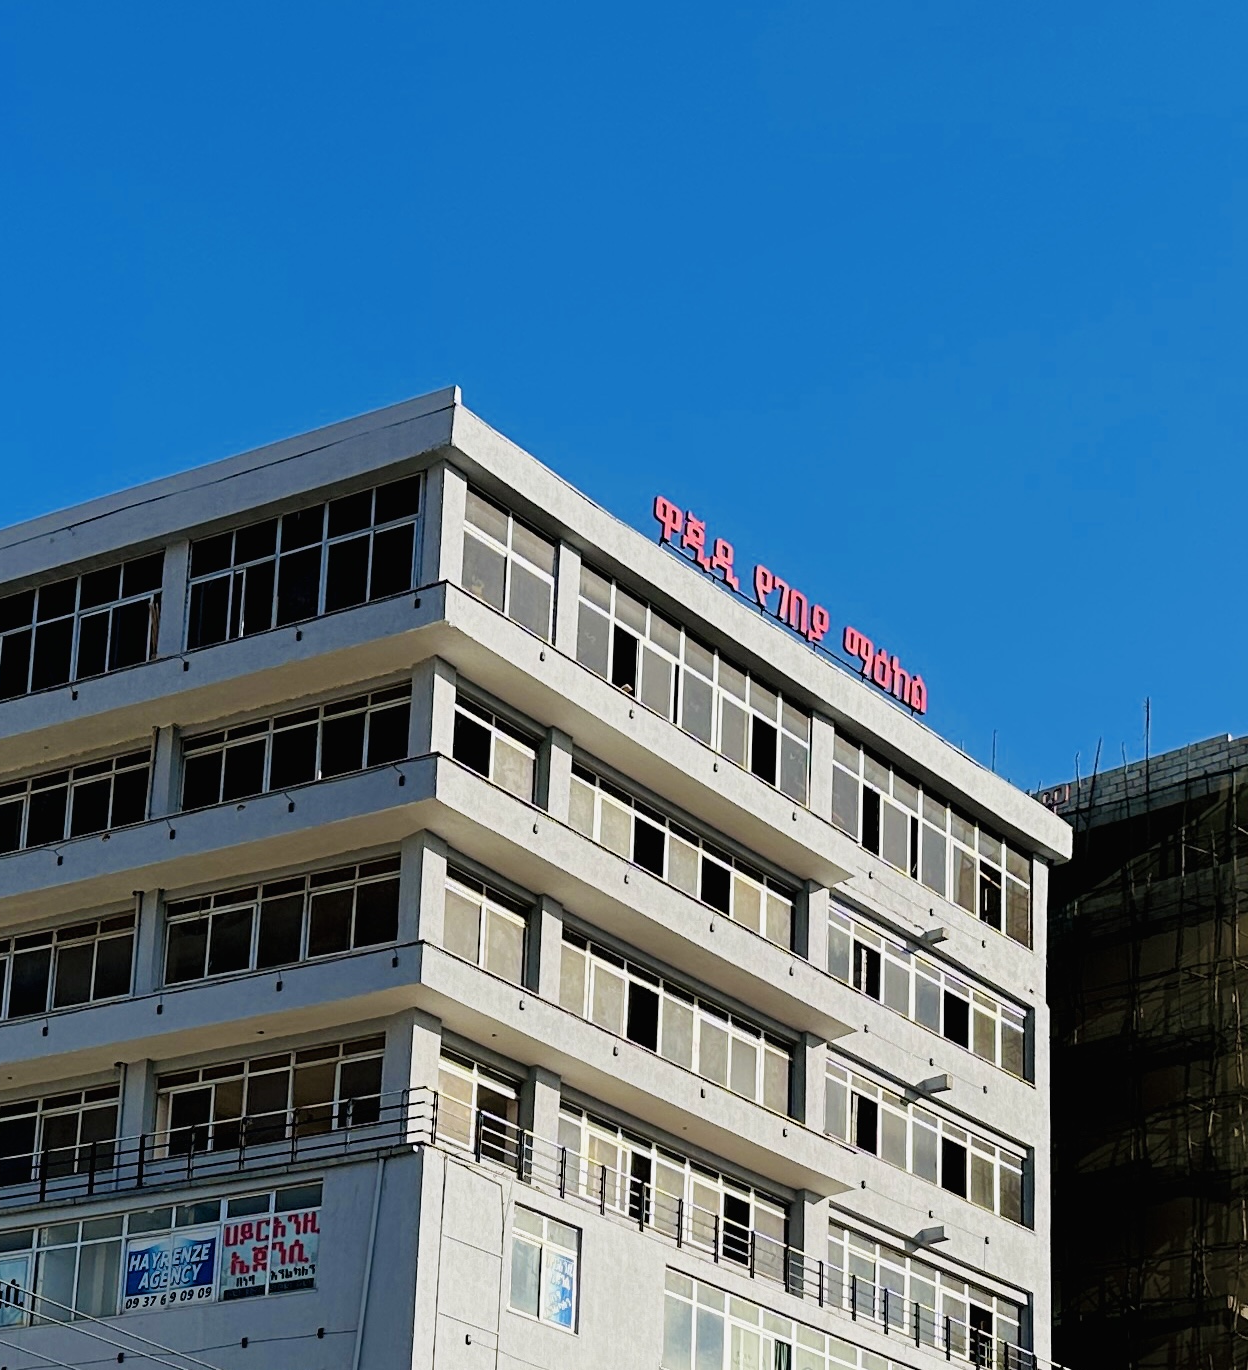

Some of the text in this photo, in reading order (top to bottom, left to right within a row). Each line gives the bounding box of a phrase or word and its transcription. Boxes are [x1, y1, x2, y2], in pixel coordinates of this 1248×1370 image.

[128, 1242, 212, 1272] HAYRENZE
[230, 1239, 309, 1276] ኤጀንሲ
[138, 1263, 202, 1291] AGENCY
[125, 1296, 140, 1310] 09
[143, 1295, 157, 1308] 37
[179, 1288, 194, 1302] 09
[197, 1286, 212, 1299] 09
